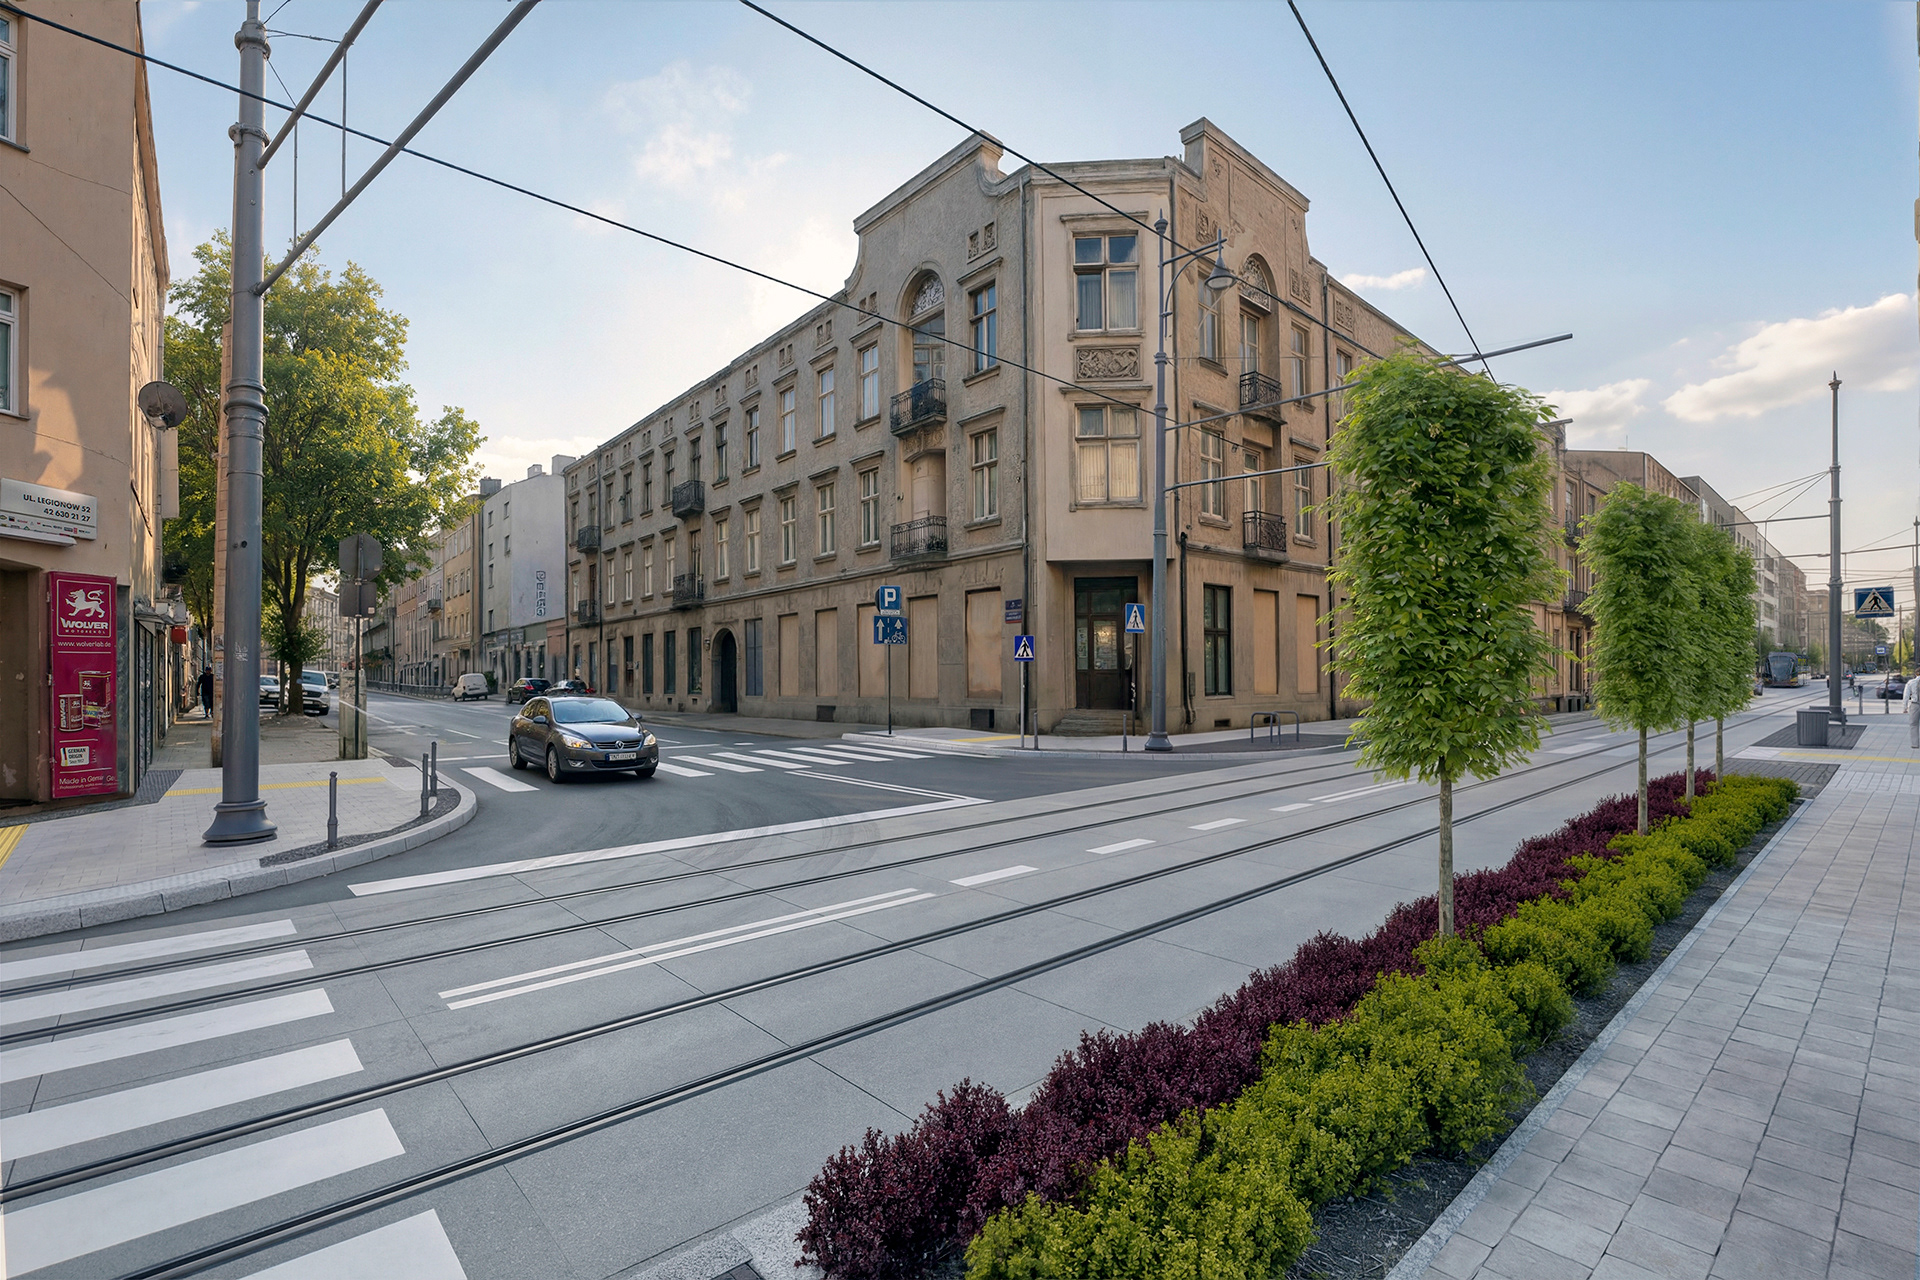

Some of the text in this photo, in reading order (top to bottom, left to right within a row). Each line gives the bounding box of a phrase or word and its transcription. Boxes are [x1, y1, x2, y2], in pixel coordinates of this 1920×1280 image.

[23, 494, 36, 502] UL.
[81, 505, 91, 513] 52
[43, 508, 54, 516] 42
[55, 510, 70, 519] 630
[884, 588, 896, 607] P
[60, 617, 109, 630] WOLVER
